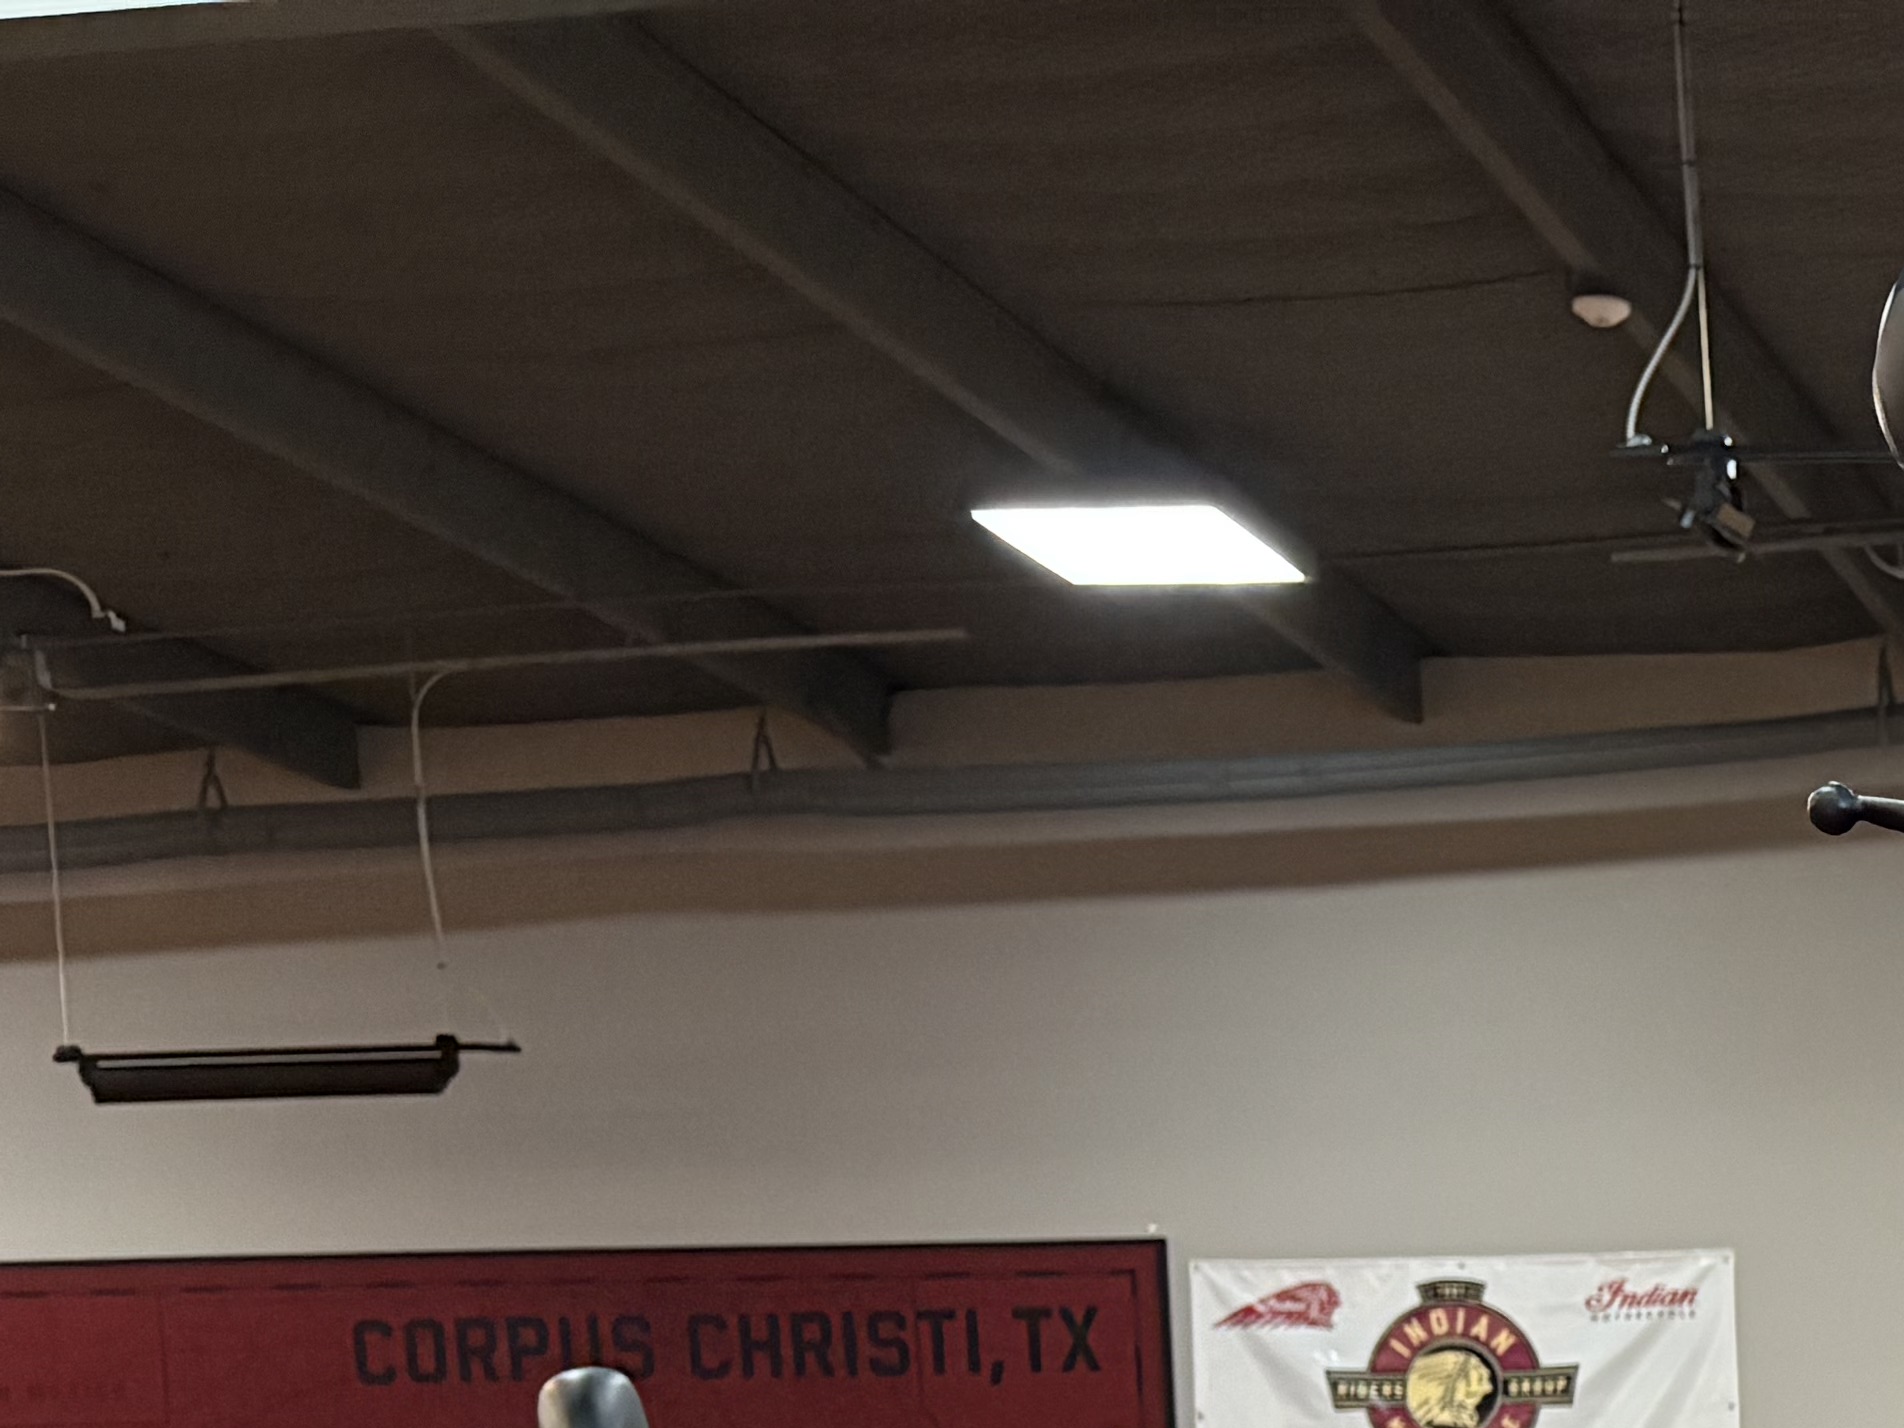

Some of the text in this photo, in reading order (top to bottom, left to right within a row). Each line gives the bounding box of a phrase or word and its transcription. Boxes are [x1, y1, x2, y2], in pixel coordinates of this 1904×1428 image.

[1584, 1278, 1698, 1312] Indian
[353, 1305, 1102, 1387] CORPUS CHRISTI, TX
[1389, 1306, 1518, 1360] INDIAN
[1336, 1381, 1405, 1402] RIDERS
